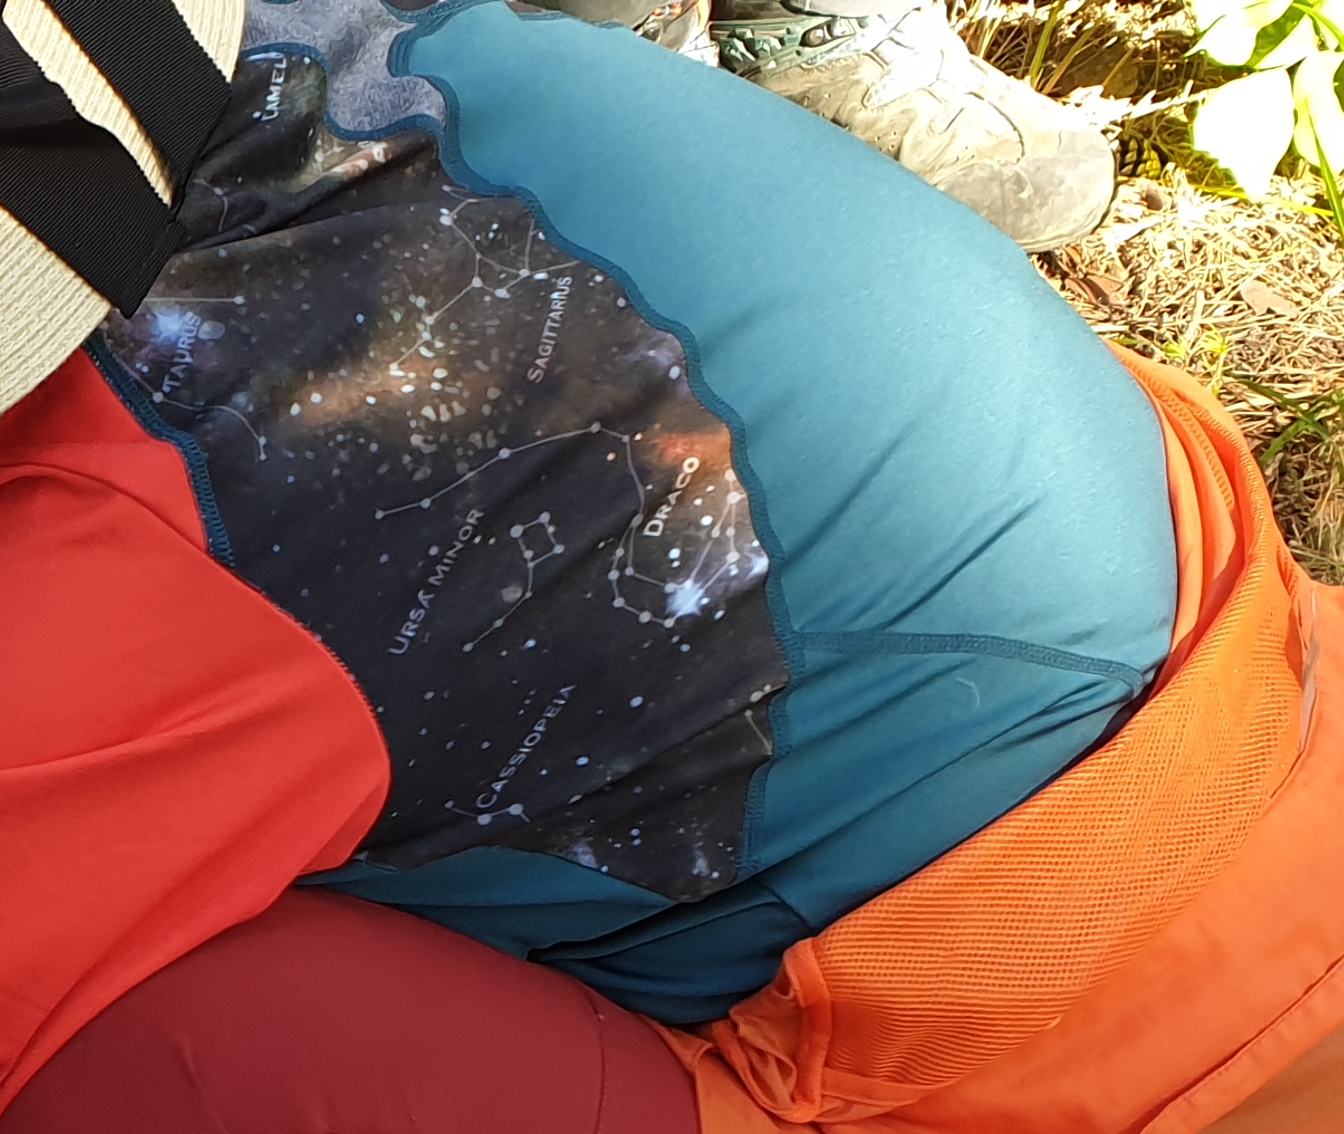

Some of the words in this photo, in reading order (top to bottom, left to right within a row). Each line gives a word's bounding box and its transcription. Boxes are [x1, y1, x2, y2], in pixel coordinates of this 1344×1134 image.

[163, 309, 201, 395] TAURUS
[528, 274, 573, 385] SAGITTARIUS
[643, 456, 701, 539] DRACO
[388, 589, 435, 658] URSA
[428, 508, 485, 591] MINOR
[474, 684, 577, 810] CASSIOPEIA
